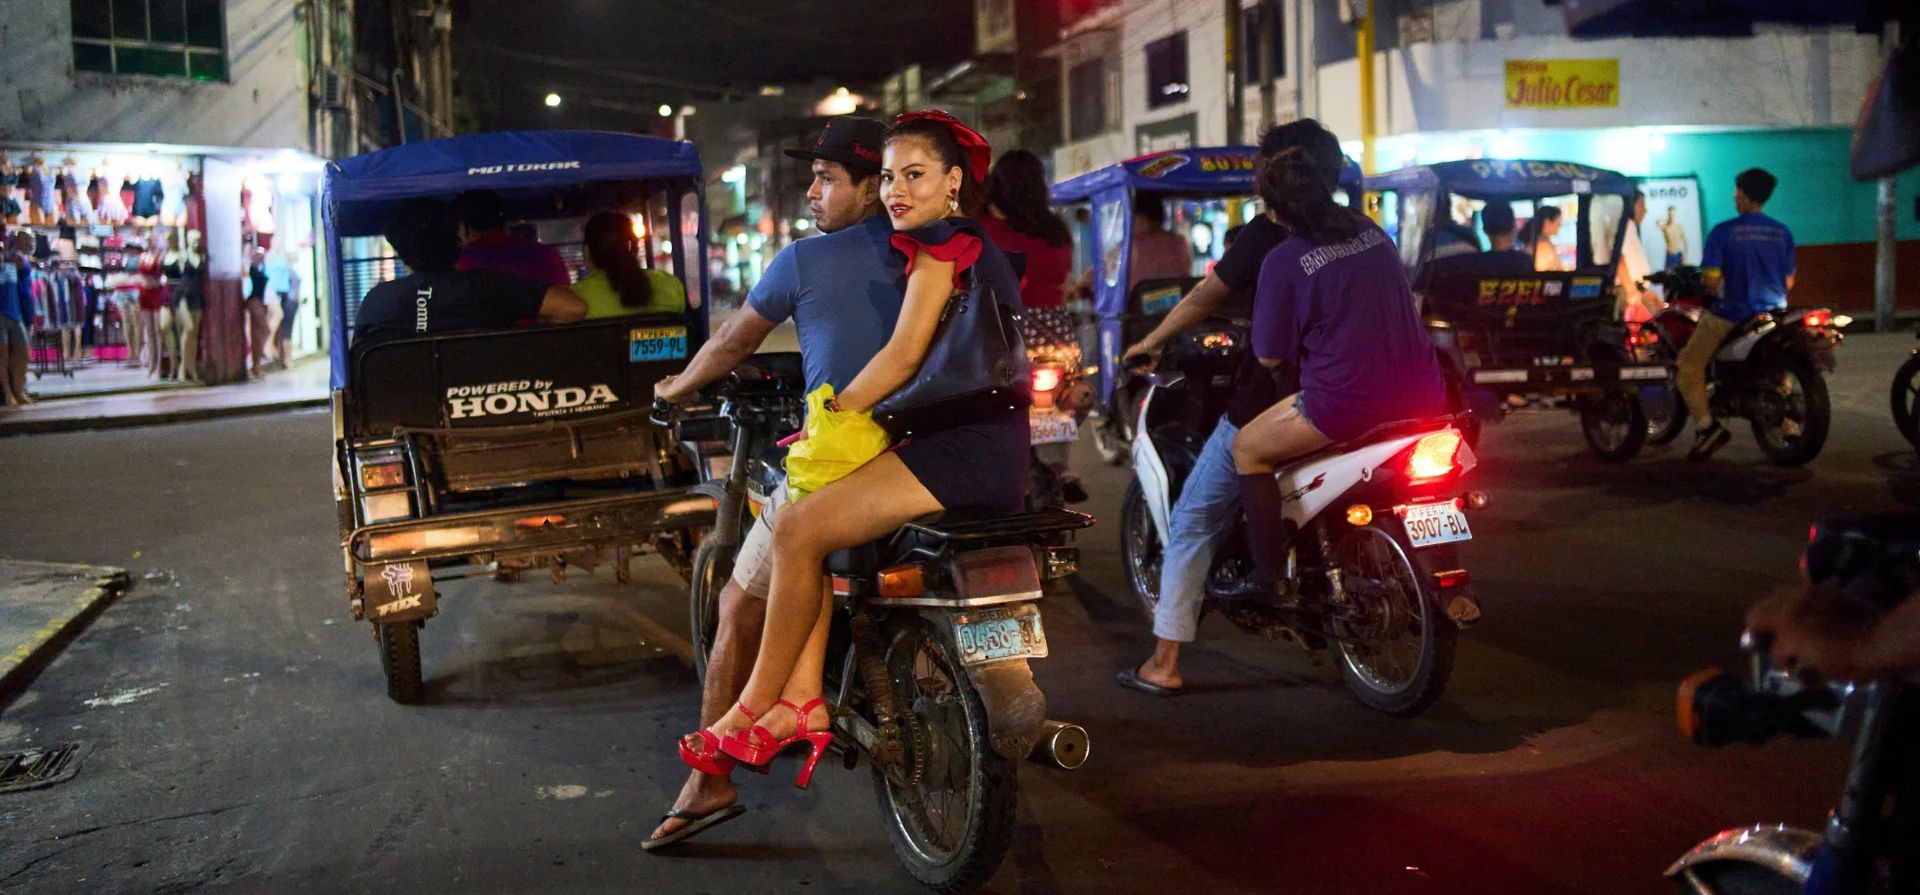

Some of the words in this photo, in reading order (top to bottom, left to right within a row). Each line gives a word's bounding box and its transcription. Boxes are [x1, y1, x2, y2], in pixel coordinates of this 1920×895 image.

[1510, 75, 1560, 105] Julio
[1564, 73, 1614, 104] Cesar
[634, 336, 684, 356] 7559-9L
[447, 380, 530, 399] POWERED
[534, 379, 553, 391] by
[448, 384, 619, 420] HONDA
[1407, 514, 1468, 541] 3907-BL
[978, 608, 1015, 622] PERU
